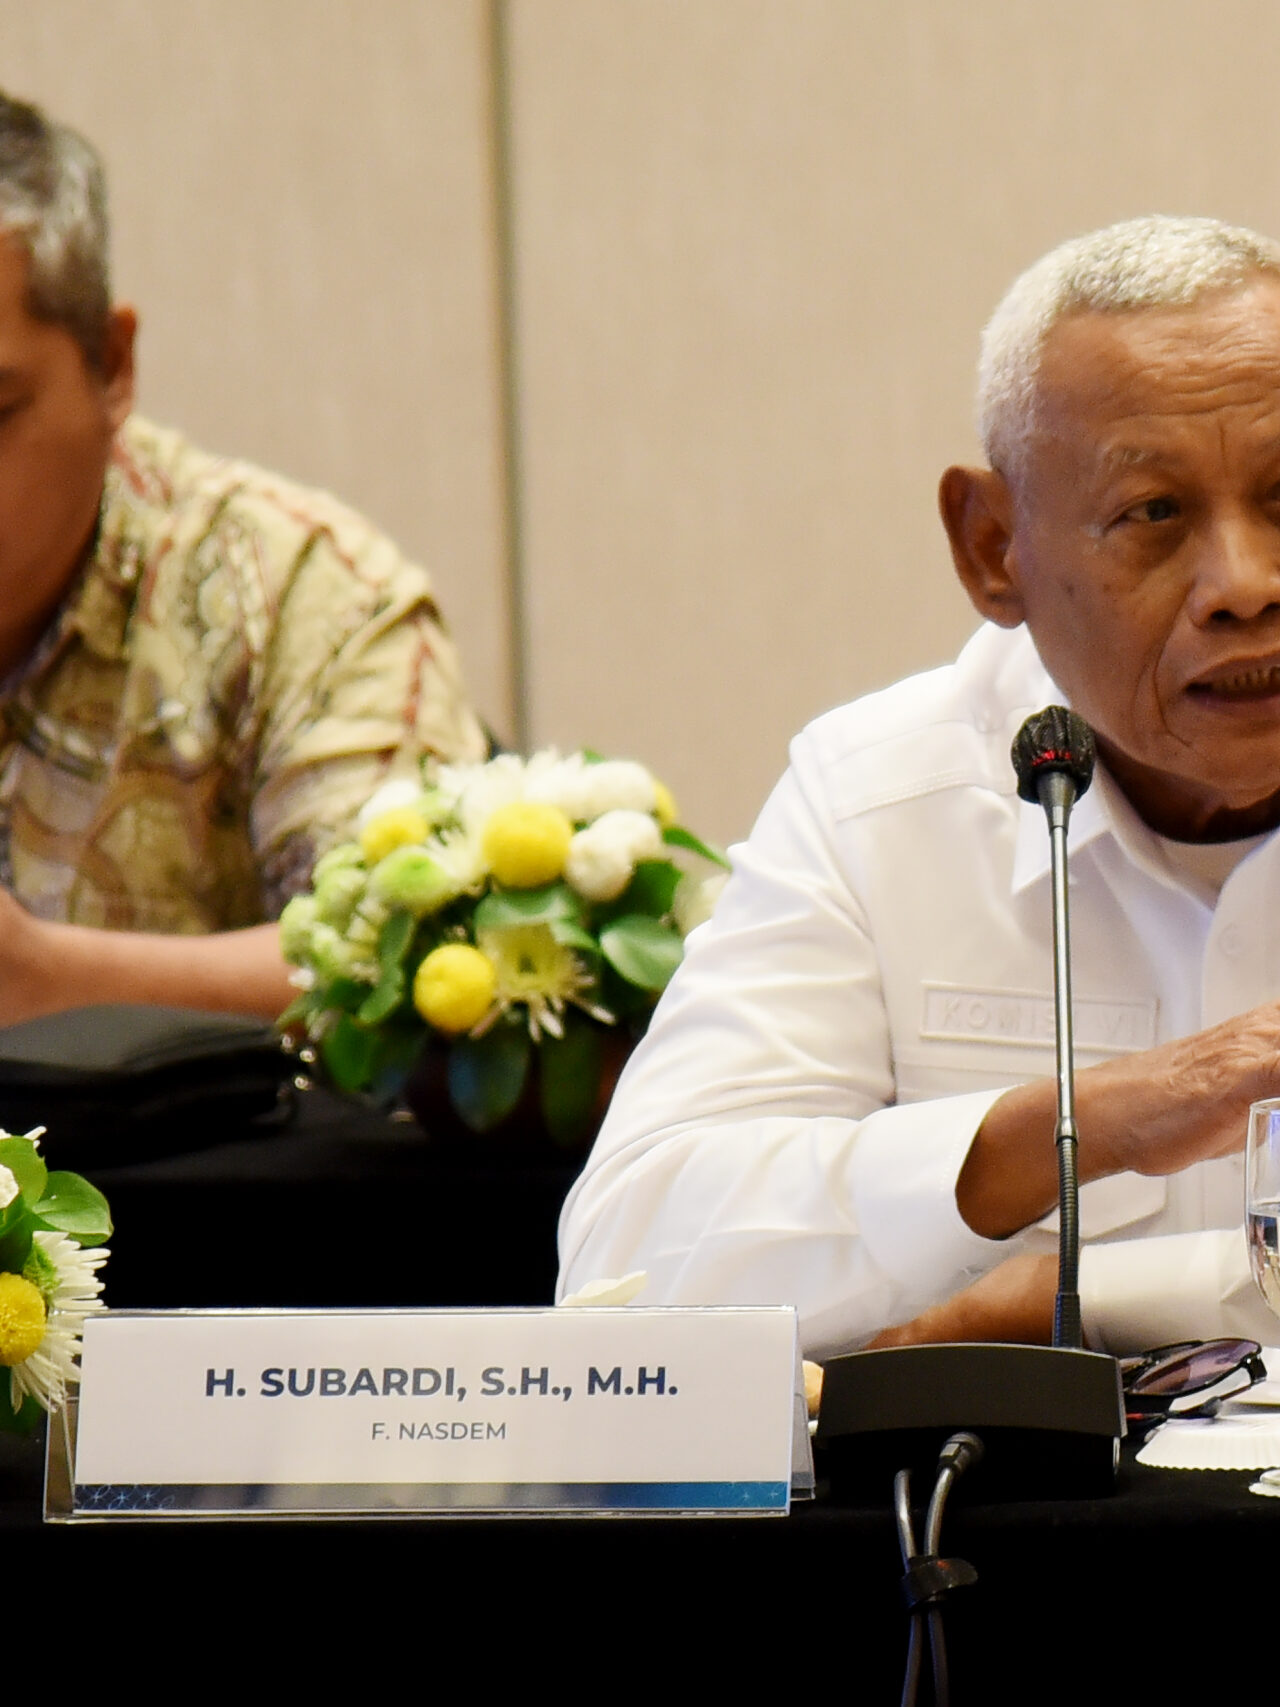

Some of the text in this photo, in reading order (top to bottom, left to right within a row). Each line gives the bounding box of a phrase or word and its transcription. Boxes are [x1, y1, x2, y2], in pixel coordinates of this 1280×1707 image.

[206, 1366, 679, 1402] H. SUBARDI, S.H., M.H.
[371, 1421, 506, 1441] F. NASDEM
